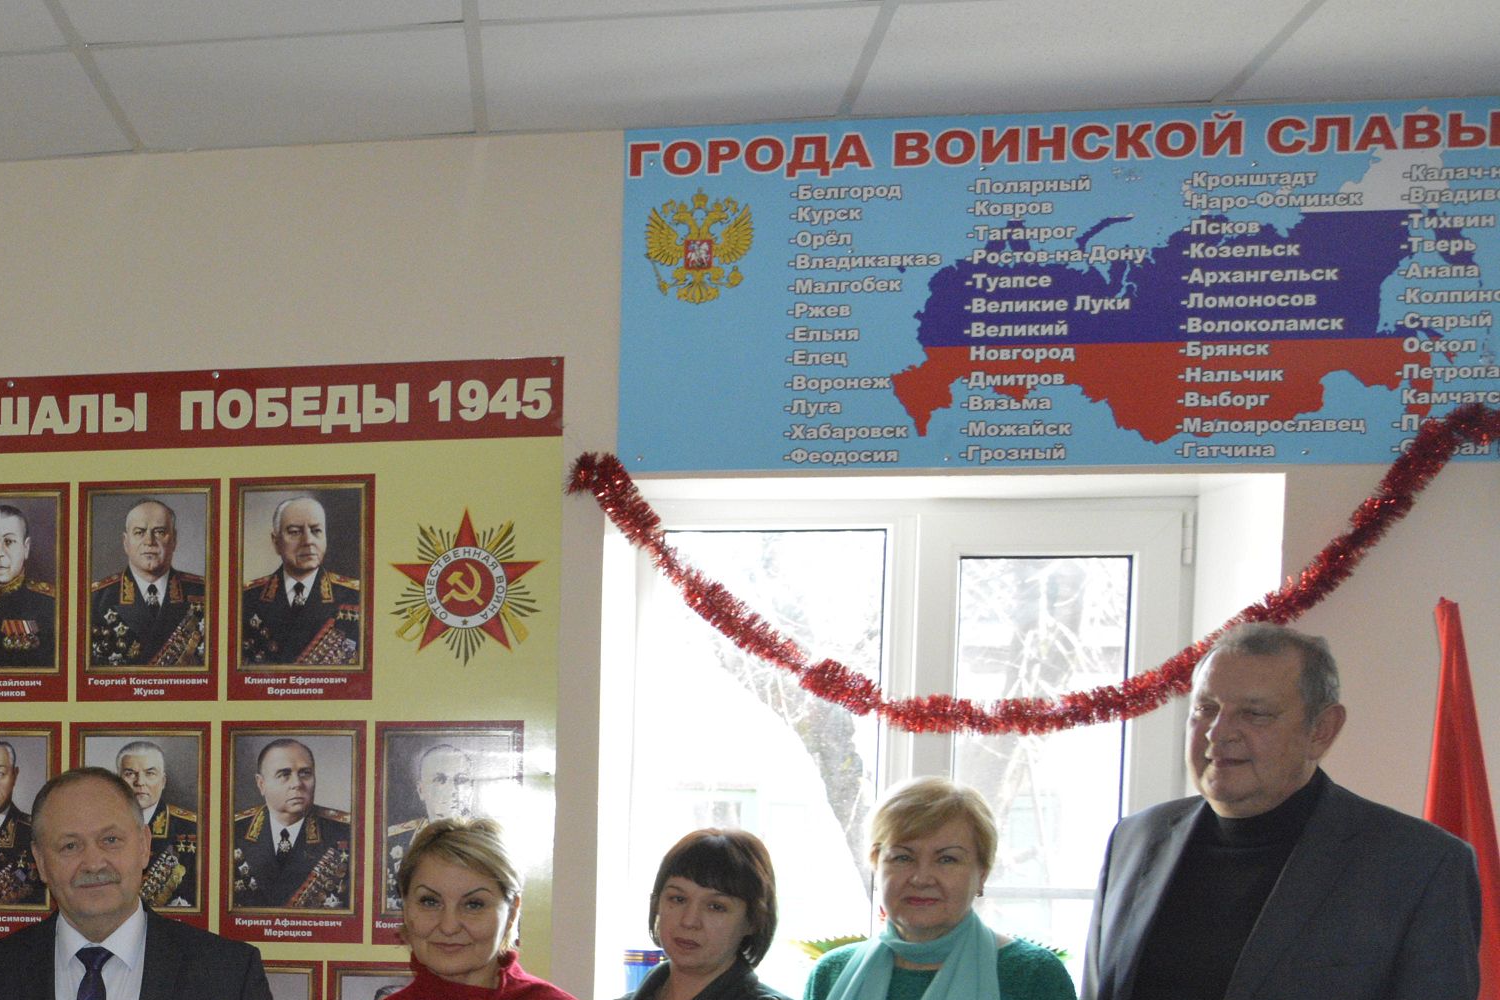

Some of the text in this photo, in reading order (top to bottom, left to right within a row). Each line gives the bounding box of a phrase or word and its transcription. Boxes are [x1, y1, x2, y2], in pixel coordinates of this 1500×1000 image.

[628, 111, 1500, 178] ГОРОДА ВОИНСКОЙ СЛАВЫ
[1401, 186, 1500, 205] -Владив
[1074, 296, 1131, 315] Луки
[1402, 337, 1477, 353] Оскол
[970, 346, 1076, 363] Новгород
[179, 383, 410, 432] ПОБЕДЫ
[427, 378, 553, 420] 1945
[427, 548, 499, 620] ОТЕЧЕСТВЕННАЯ
[88, 677, 208, 687] Георгий Константинович
[244, 675, 347, 686] Климент Ефремович
[133, 687, 165, 697] Жуков
[267, 687, 324, 695] Ворошилов
[235, 917, 342, 928] Кирилл Афанасьевич
[263, 928, 313, 938] Мерецков
